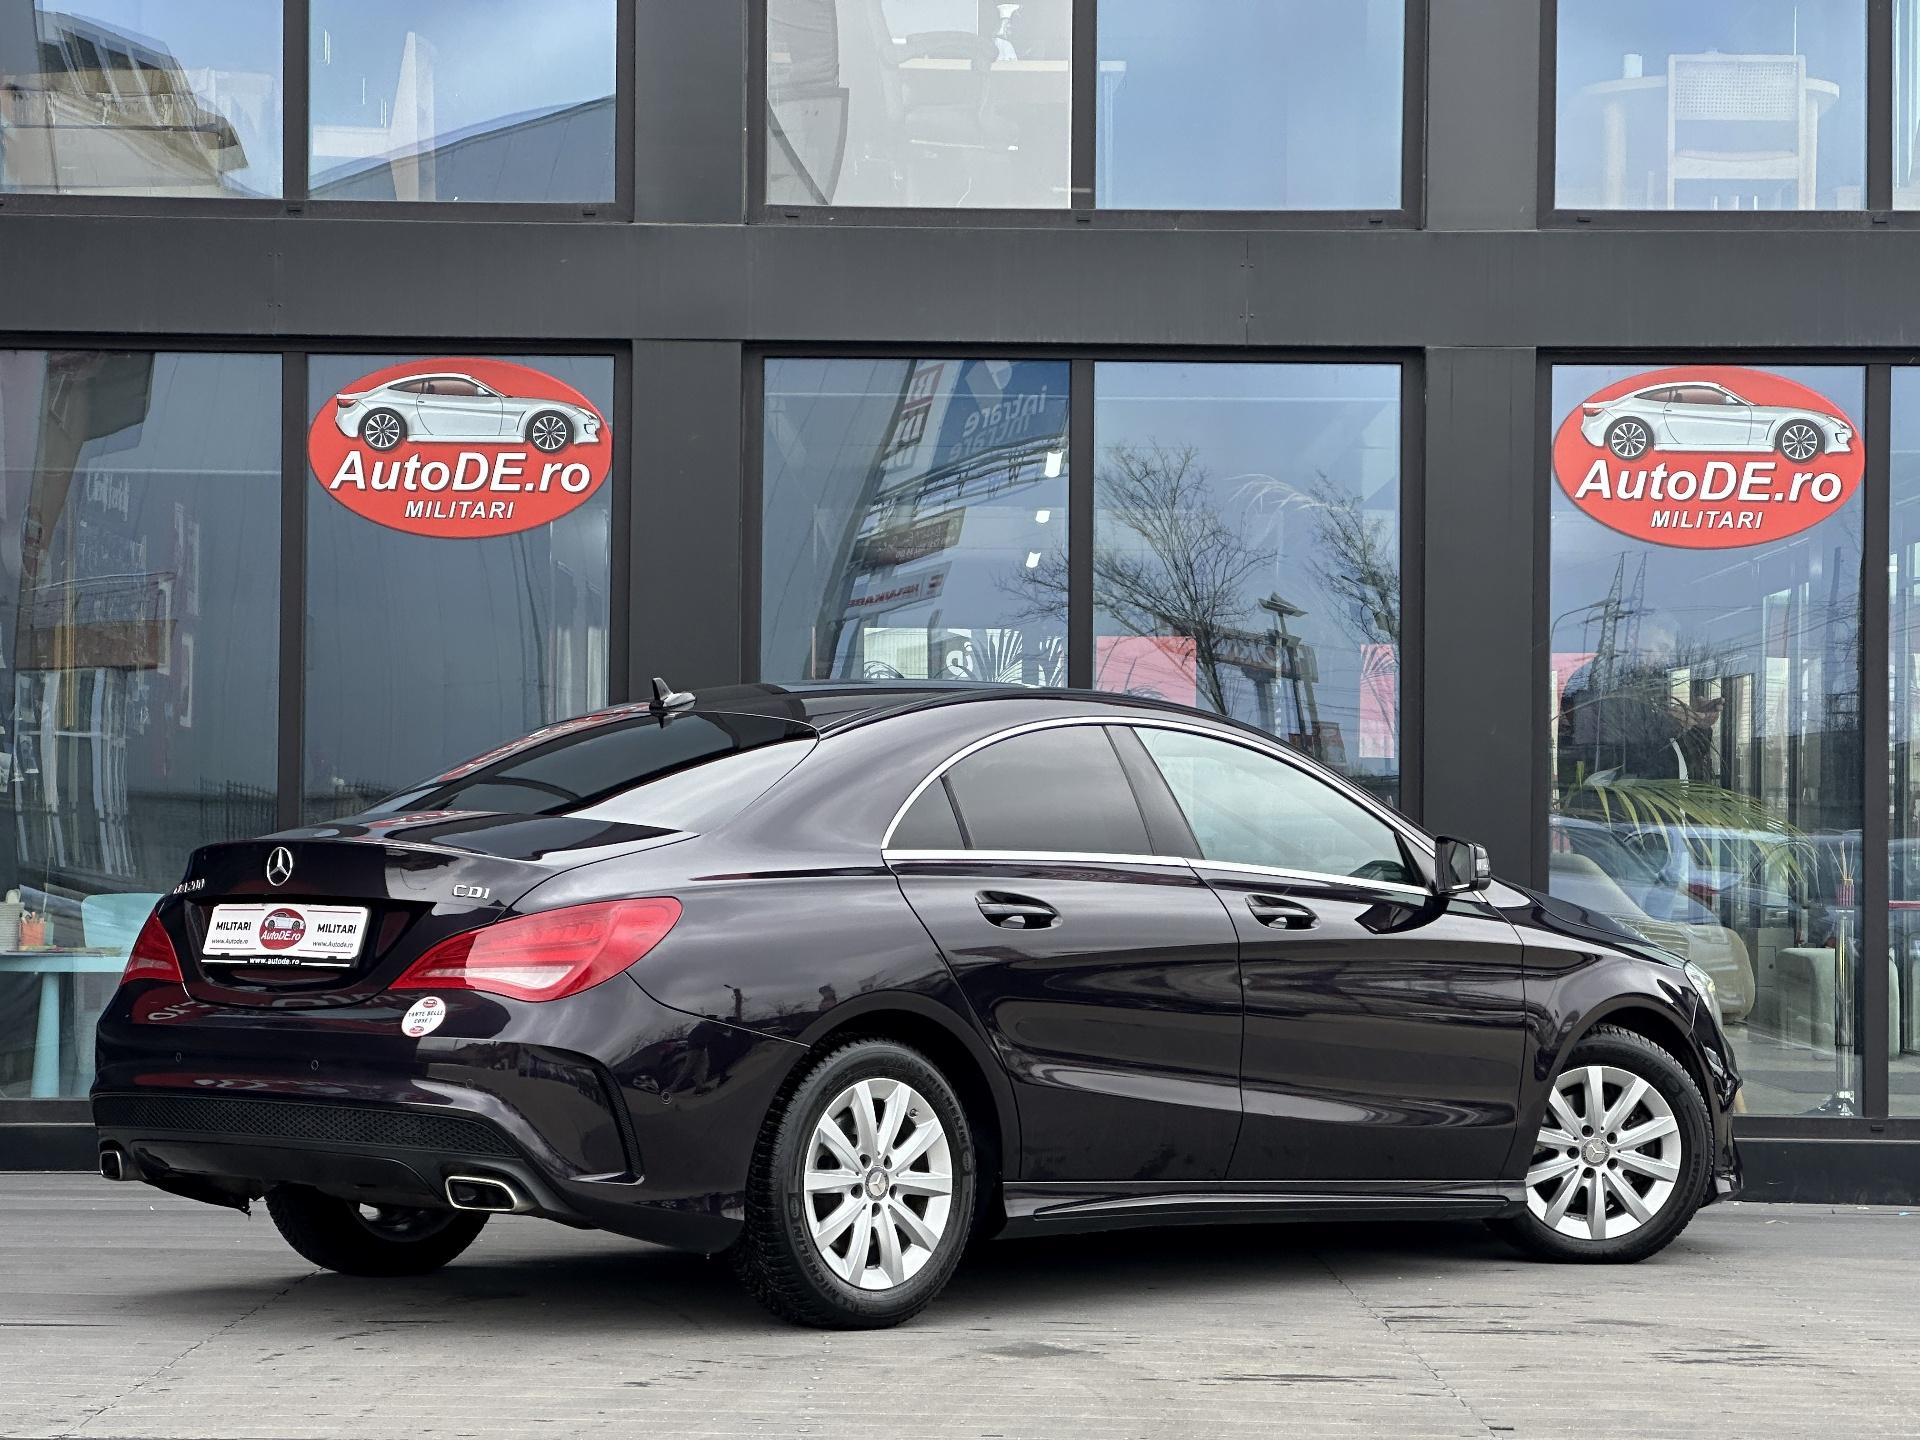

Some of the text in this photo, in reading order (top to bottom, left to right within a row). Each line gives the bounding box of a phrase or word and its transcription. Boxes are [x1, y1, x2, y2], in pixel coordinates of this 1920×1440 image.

[329, 450, 592, 493] AutoDE.ro
[1575, 459, 1842, 503] AutoDE.ro
[404, 501, 515, 520] MILITARI
[1650, 510, 1763, 529] MILITARI
[453, 884, 490, 900] CDI
[215, 921, 252, 931] MILITARI
[316, 923, 357, 934] MILITARI
[260, 930, 302, 941] AutoDE.ro
[312, 940, 354, 948] www.Autode.ro
[249, 957, 300, 965] www.autode.ro
